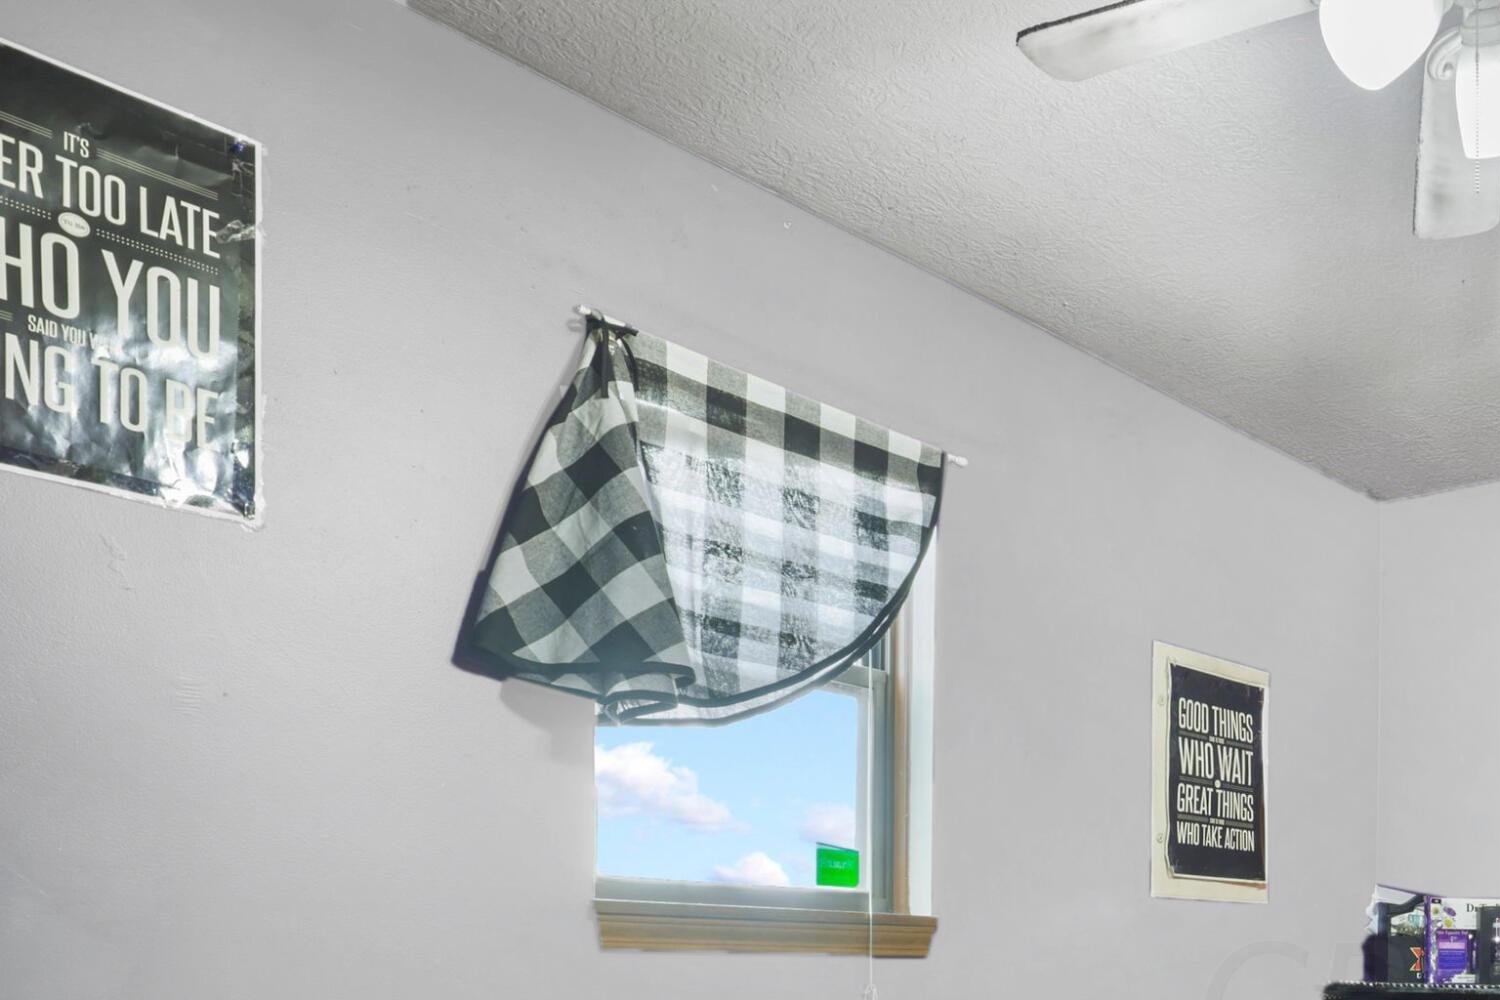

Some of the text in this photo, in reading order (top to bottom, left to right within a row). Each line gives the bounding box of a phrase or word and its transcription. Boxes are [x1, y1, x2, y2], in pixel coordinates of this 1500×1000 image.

[63, 131, 89, 158] IT'S
[55, 154, 126, 226] TOO
[139, 185, 220, 259] LATE
[101, 248, 220, 359] YOU
[27, 314, 58, 339] SAID
[61, 324, 86, 347] YOU
[91, 356, 149, 432] TO
[165, 378, 220, 451] BE
[1179, 697, 1254, 743] GOOD THINGS
[1178, 736, 1254, 786] WHO WAIT
[1177, 782, 1254, 822] GREAT THINGS
[1176, 820, 1255, 853] WHO TAKE ACTION
